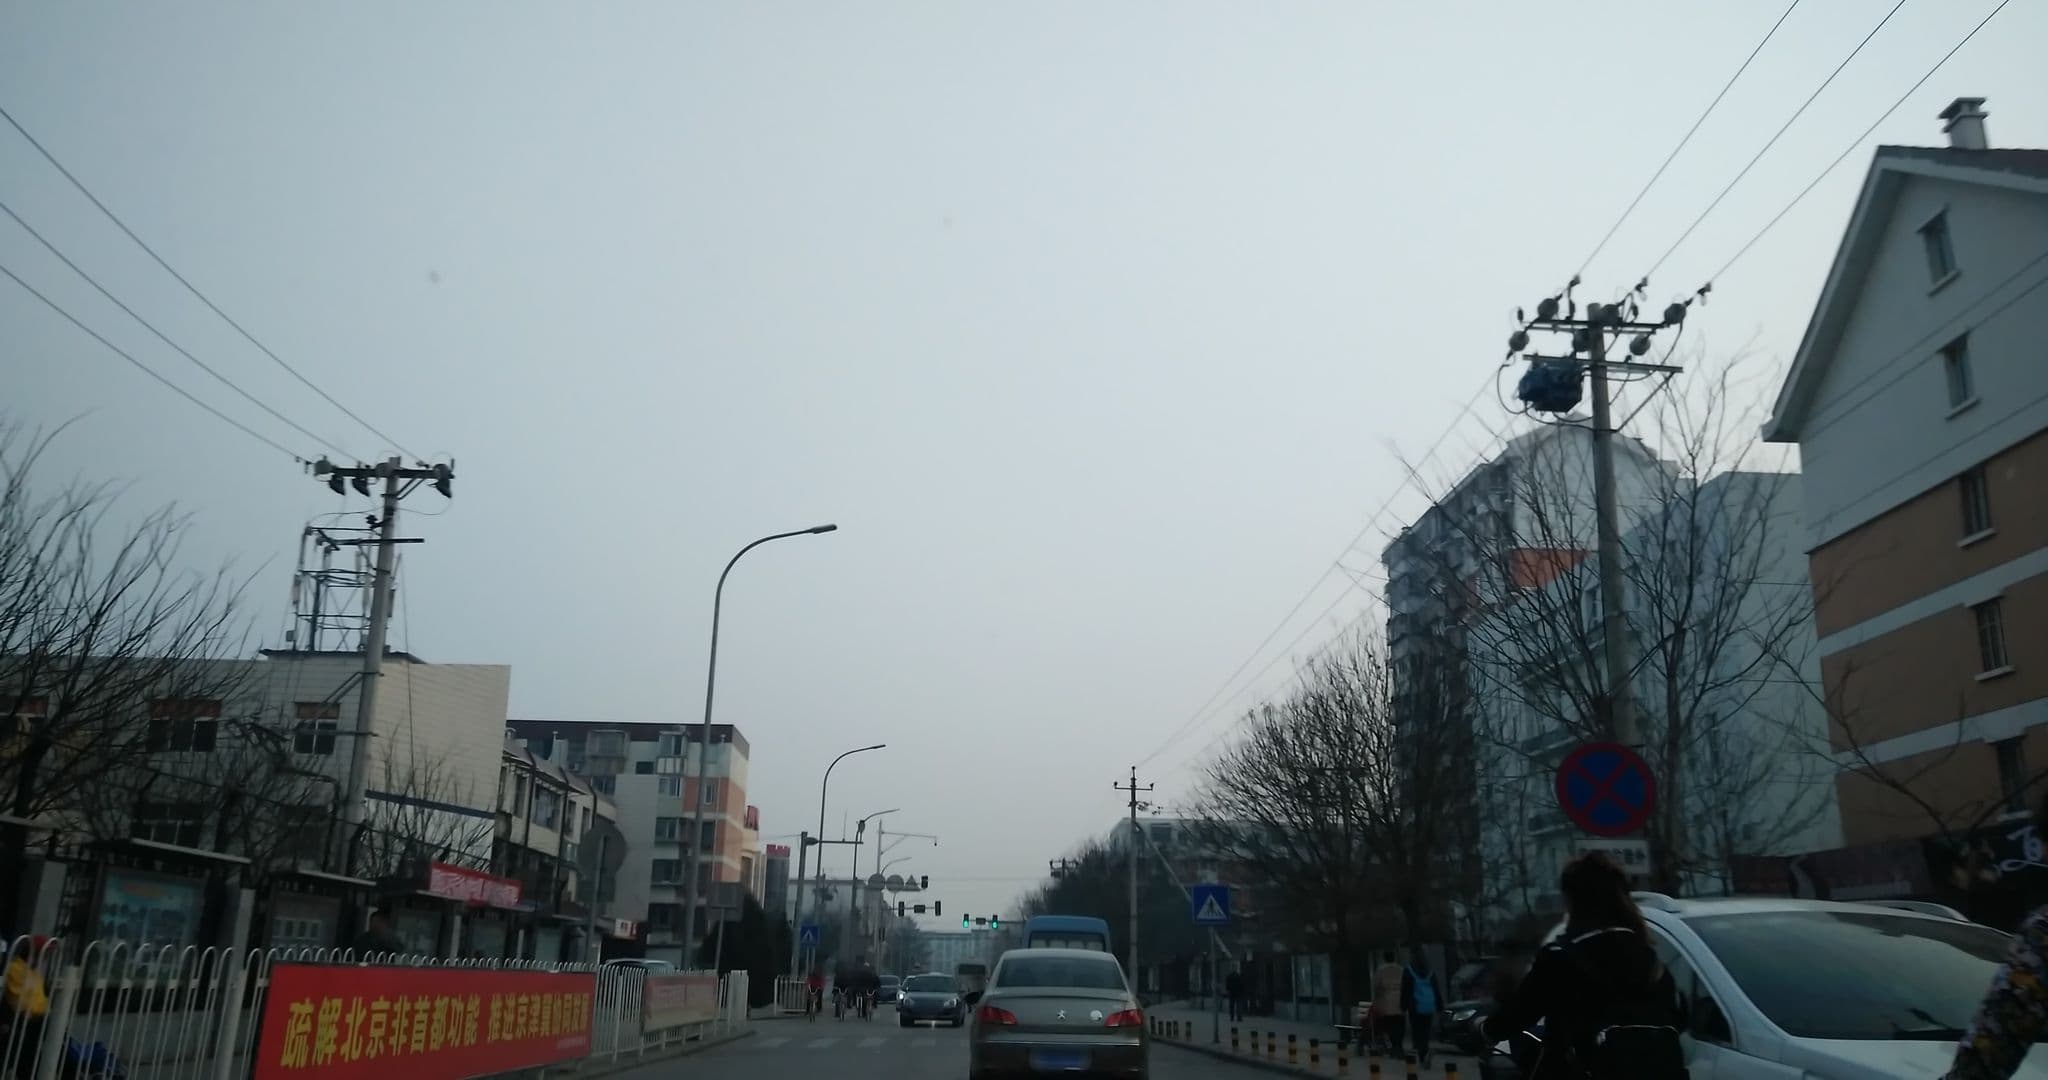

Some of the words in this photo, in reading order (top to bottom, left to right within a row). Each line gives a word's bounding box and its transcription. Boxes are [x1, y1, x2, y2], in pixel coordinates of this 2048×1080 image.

[281, 993, 481, 1069] 疏解北京非首都功能
